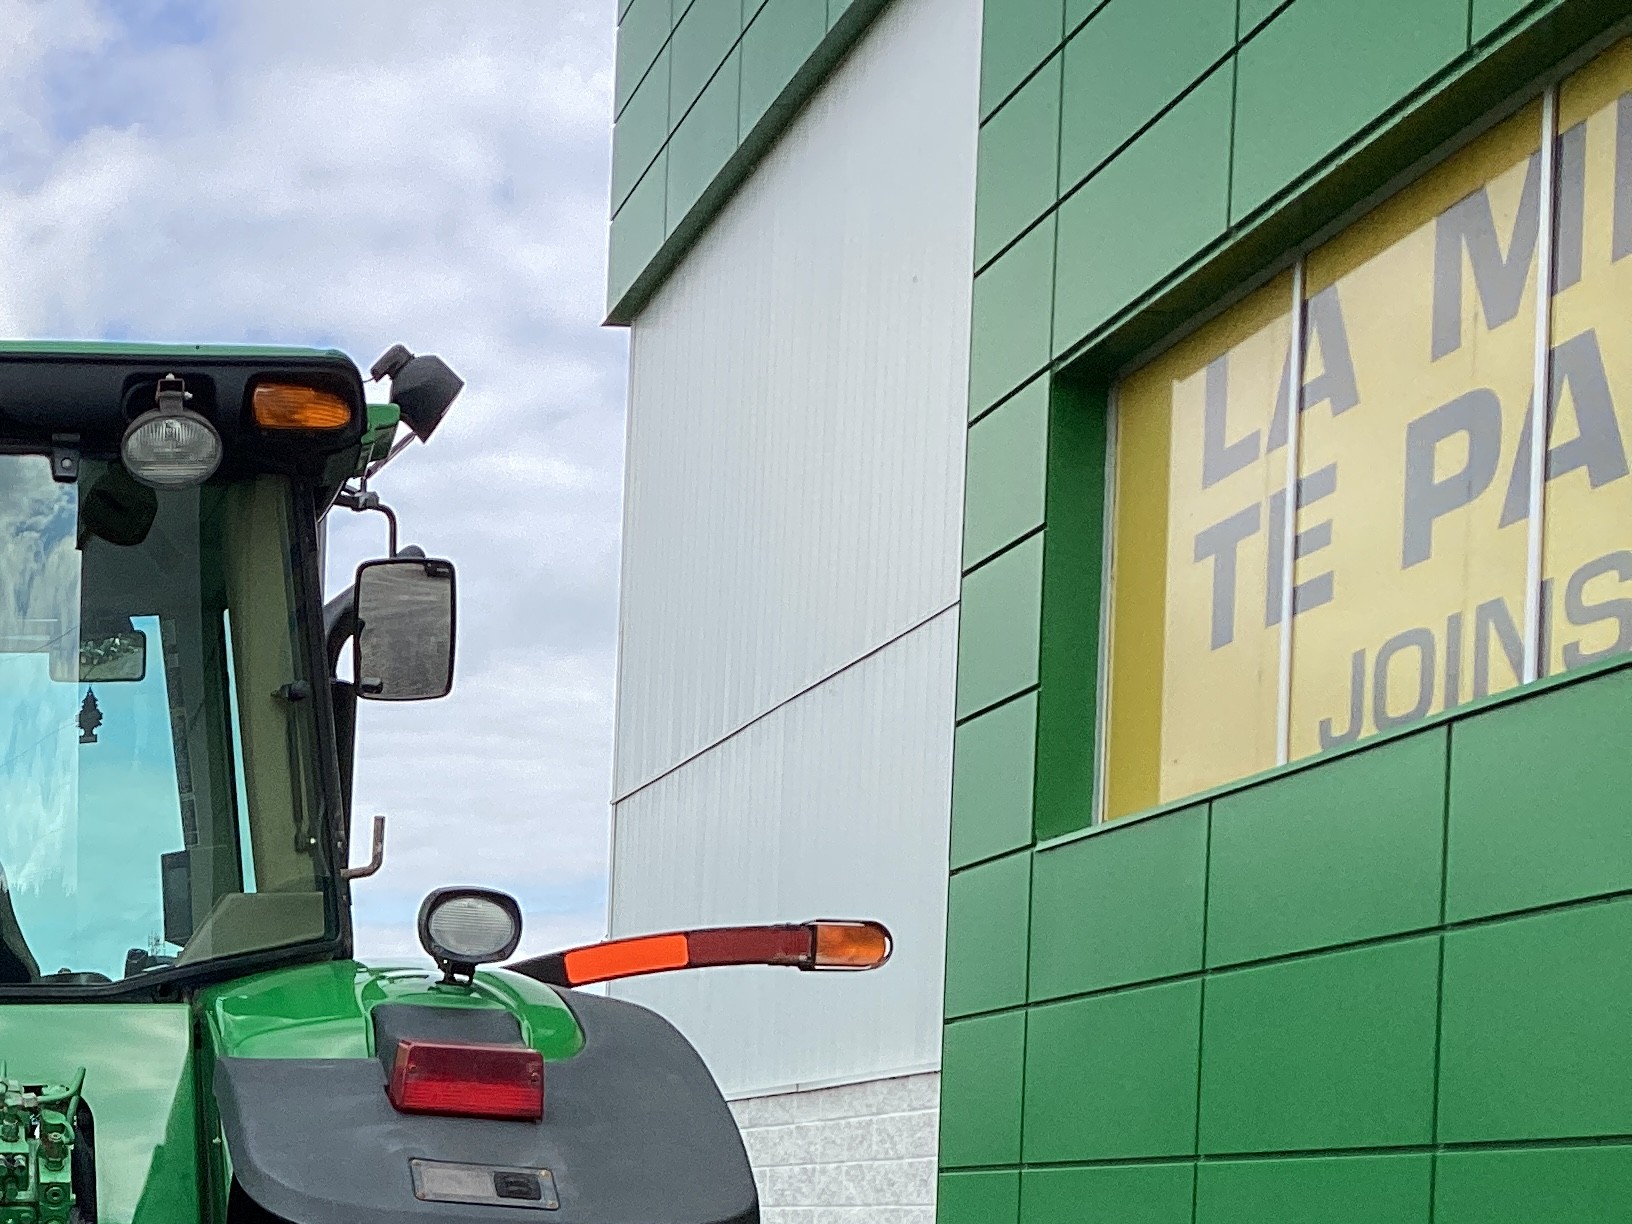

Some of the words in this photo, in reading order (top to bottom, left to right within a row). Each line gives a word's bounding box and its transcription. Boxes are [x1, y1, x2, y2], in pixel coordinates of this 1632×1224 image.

[1193, 462, 1337, 651] TE
[1401, 326, 1630, 570] PA
[1202, 280, 1359, 490] LA
[1319, 551, 1632, 750] JOINS
